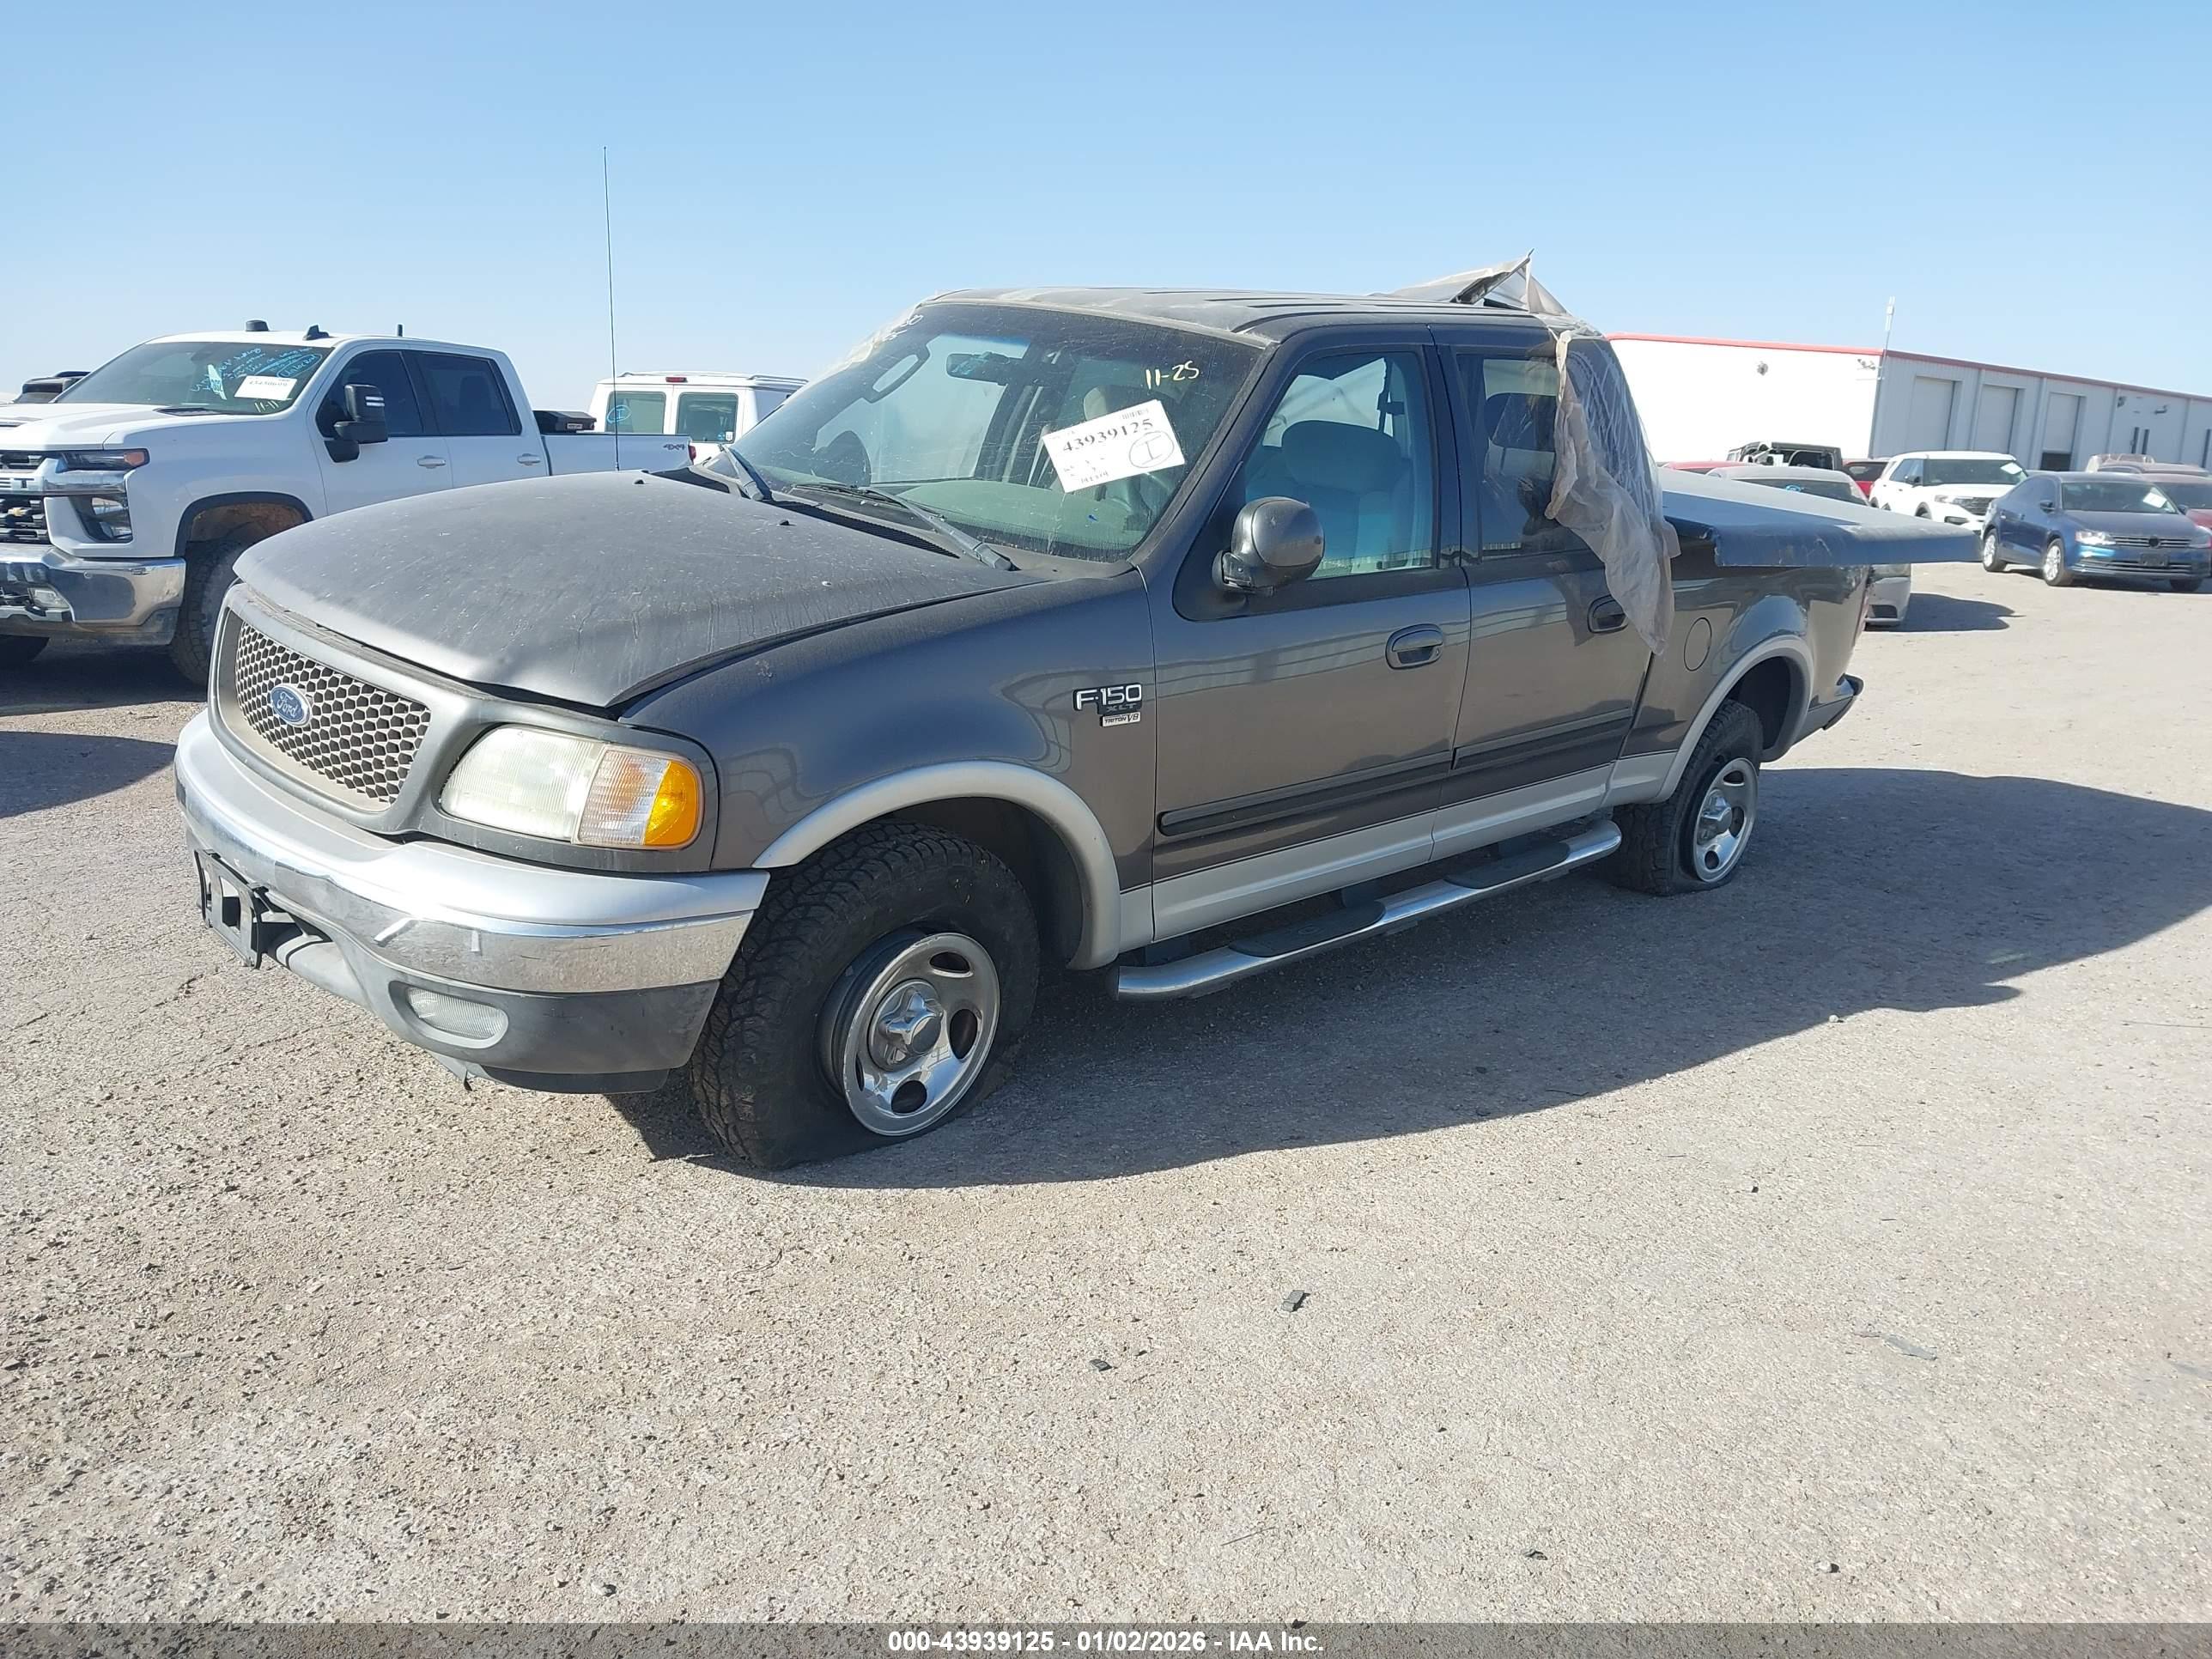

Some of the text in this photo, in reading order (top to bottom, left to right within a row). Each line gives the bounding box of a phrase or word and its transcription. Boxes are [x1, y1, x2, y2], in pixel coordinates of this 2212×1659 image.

[1146, 361, 1200, 389] 11-25
[1062, 417, 1154, 452] 43939125
[276, 690, 299, 718] Ford
[1076, 684, 1142, 710] F-150
[1105, 702, 1137, 713] XLT
[1127, 713, 1139, 723] V8
